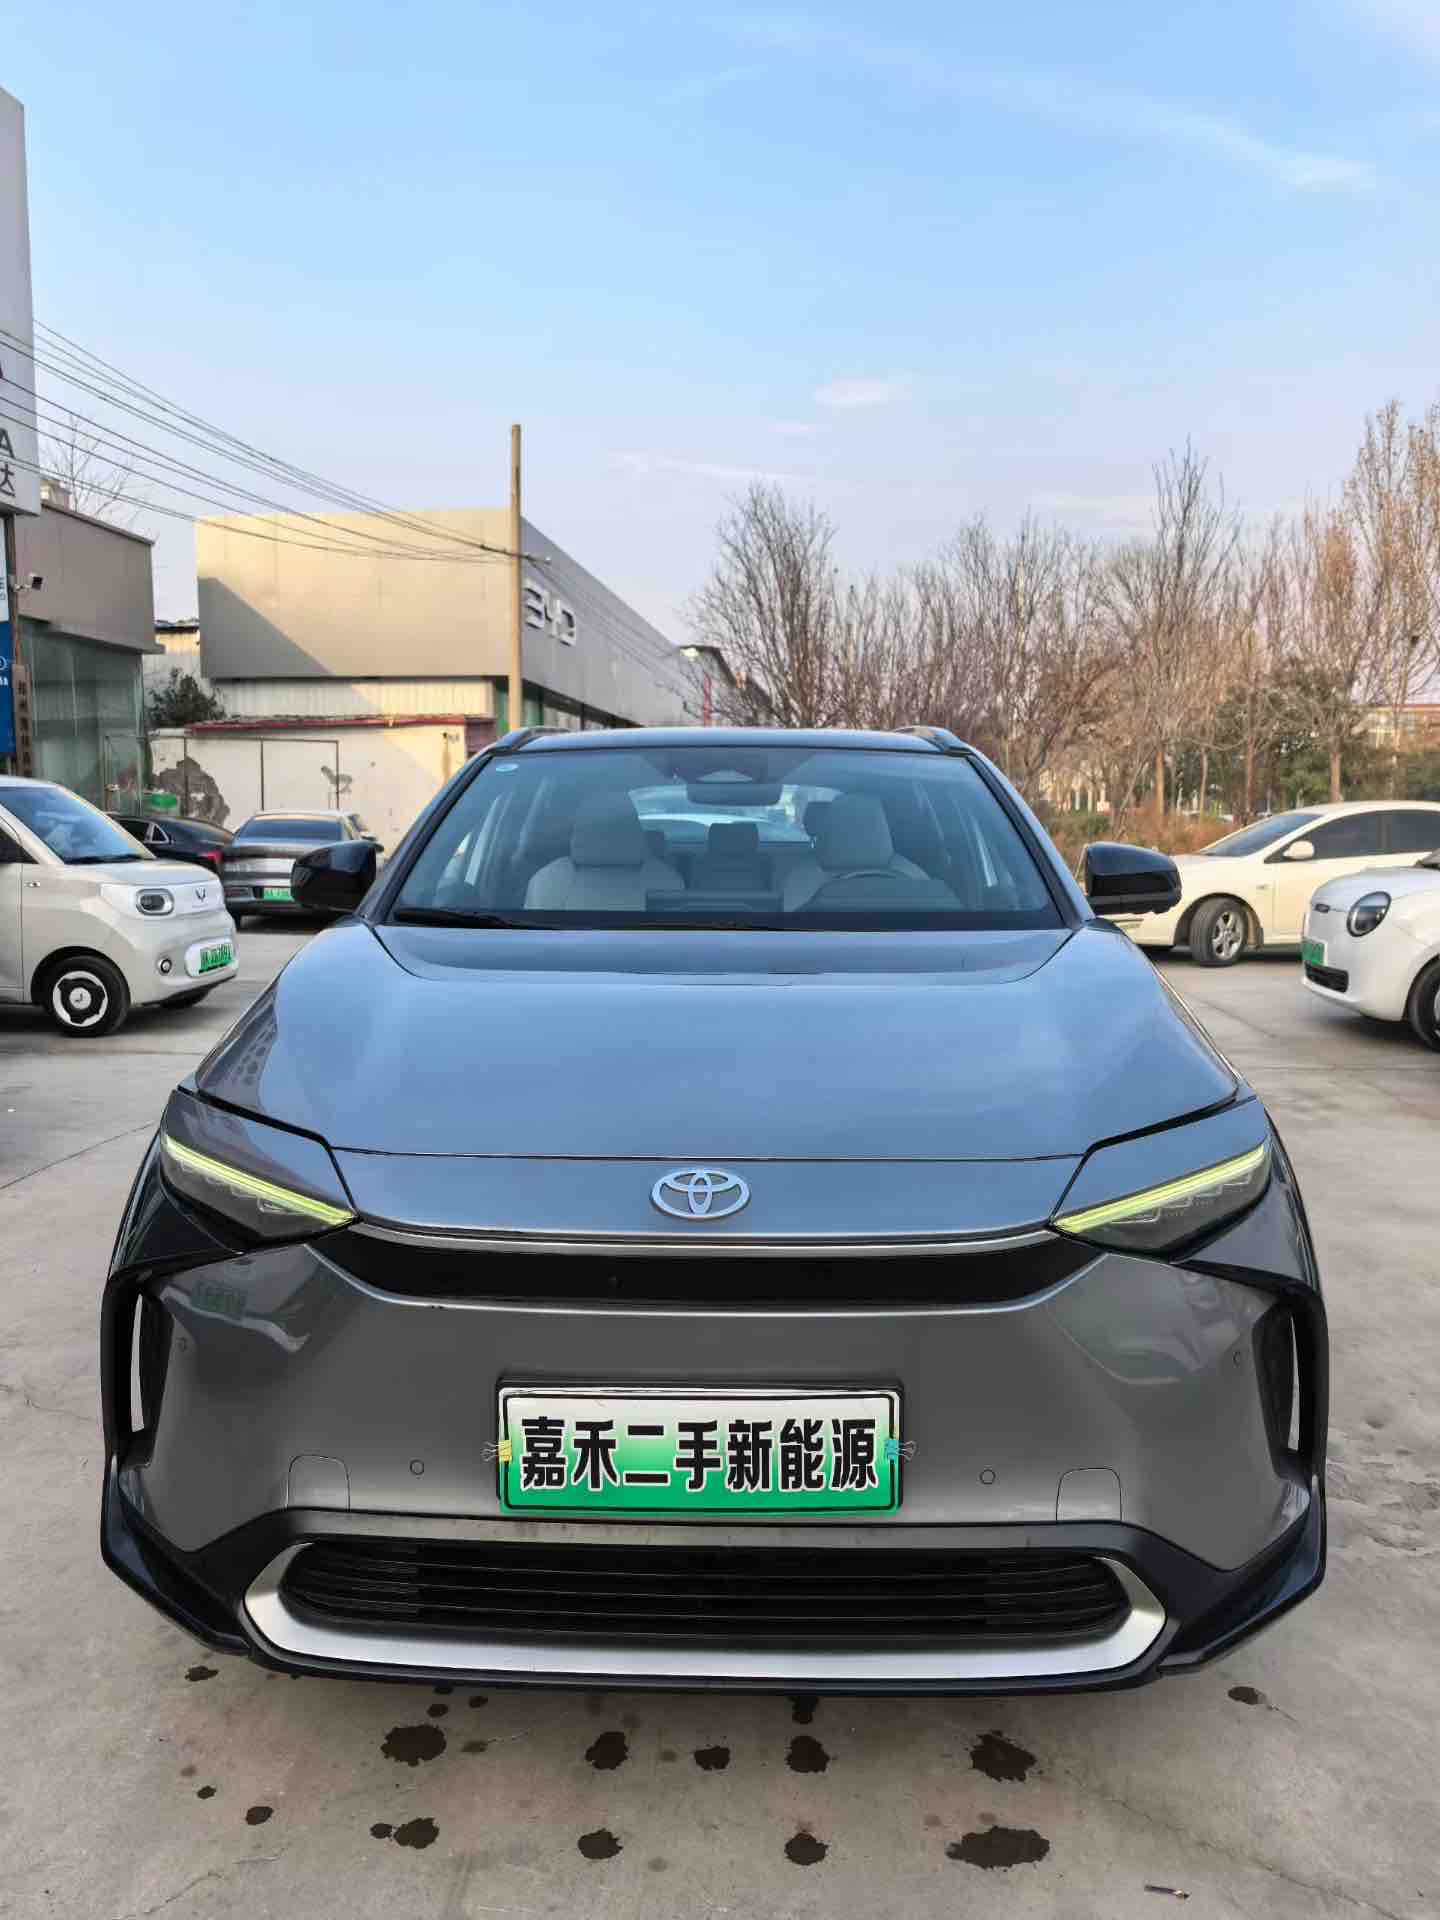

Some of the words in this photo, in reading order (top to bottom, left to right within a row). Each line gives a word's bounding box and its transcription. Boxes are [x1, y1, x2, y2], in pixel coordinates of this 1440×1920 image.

[520, 1415, 877, 1491] 嘉禾二手新能源
